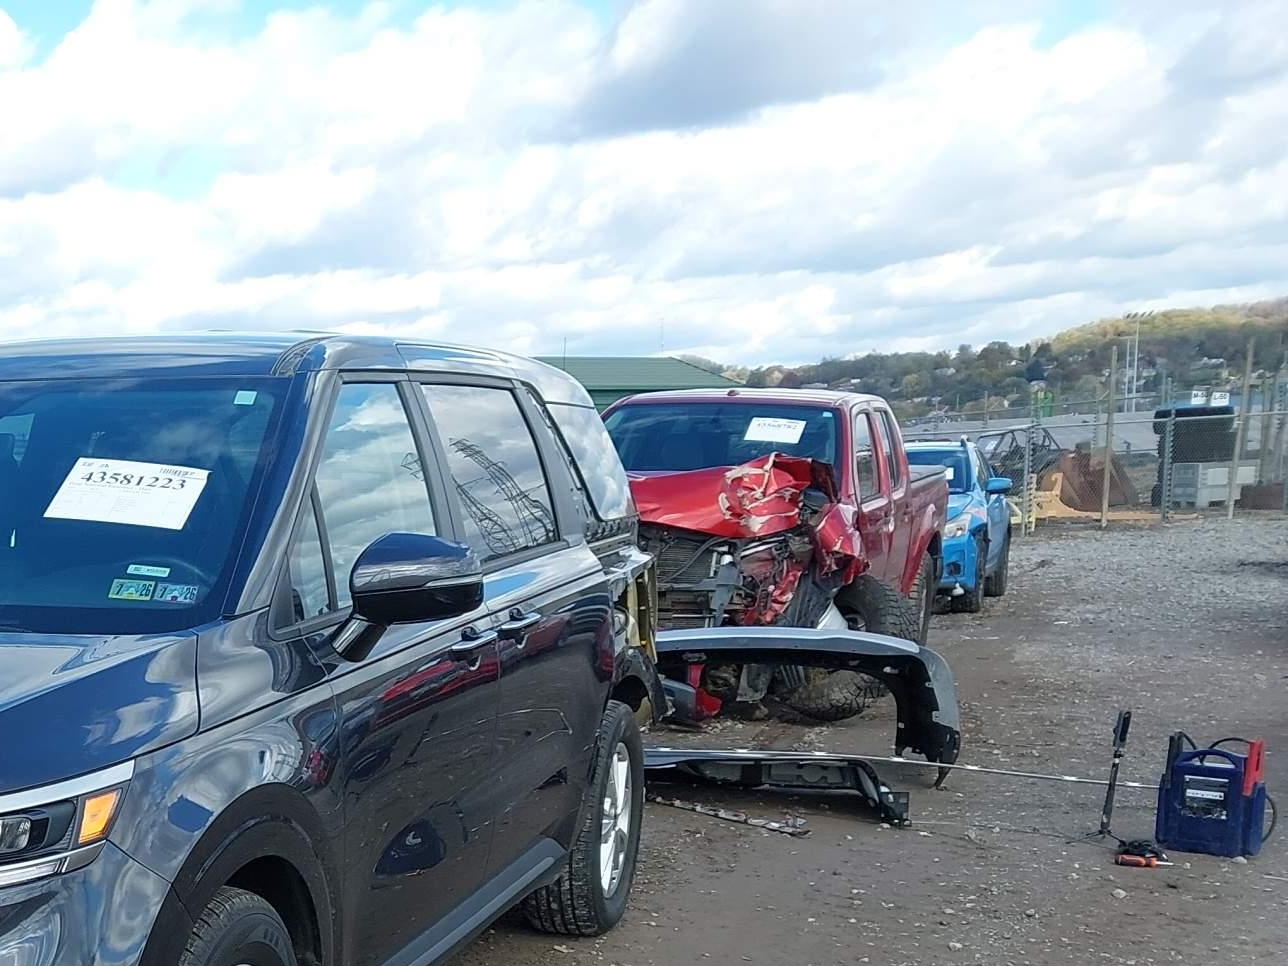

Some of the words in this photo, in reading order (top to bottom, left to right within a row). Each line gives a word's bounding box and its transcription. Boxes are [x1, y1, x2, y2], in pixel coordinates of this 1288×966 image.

[81, 471, 187, 491] 43581223
[116, 583, 124, 595] 7
[139, 583, 153, 597] 26
[183, 586, 197, 600] 26
